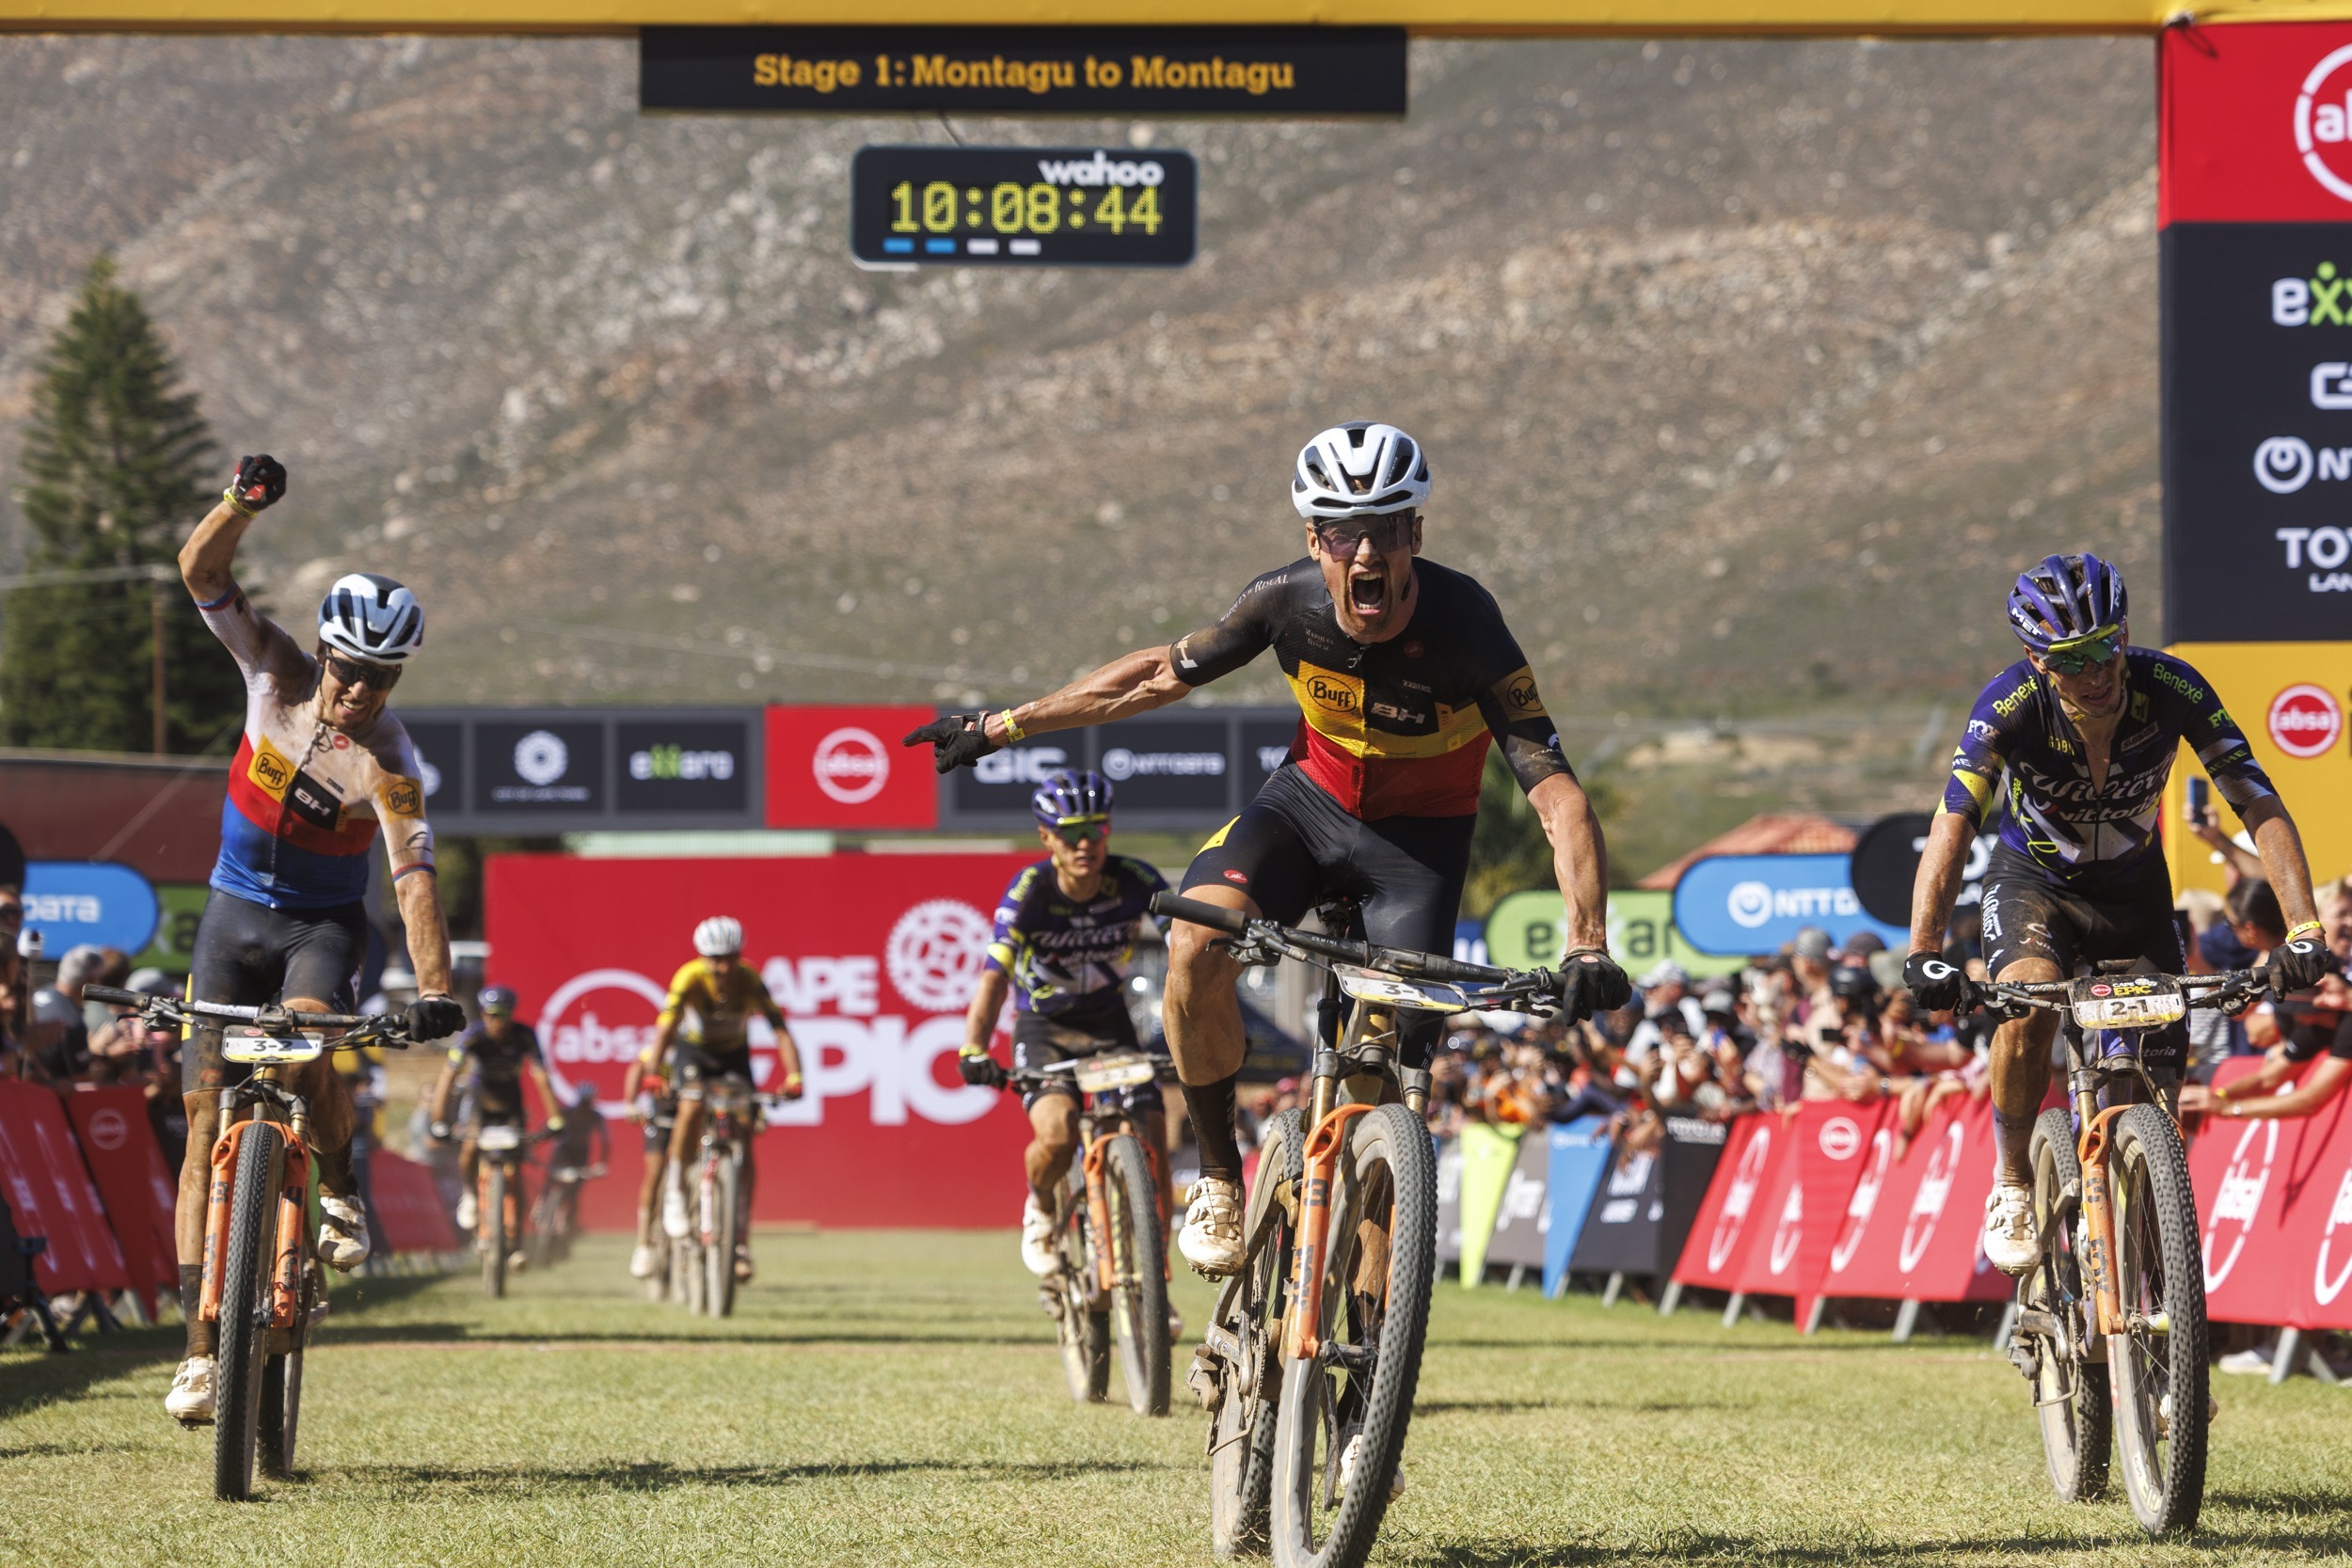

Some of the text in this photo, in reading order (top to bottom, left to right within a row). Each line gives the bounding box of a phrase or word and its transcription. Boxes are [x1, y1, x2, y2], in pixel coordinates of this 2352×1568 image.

[754, 54, 1295, 95] Stage 1: Montagu to Montagu
[1039, 150, 1164, 185] wahoo
[891, 181, 1163, 235] 10:08:44
[2011, 607, 2042, 636] MET
[1371, 702, 1425, 724] BH
[294, 786, 331, 816] BH
[1311, 935, 1338, 945] GEMINI
[762, 955, 880, 1015] APE
[2113, 985, 2153, 996] EPIC
[2110, 999, 2149, 1016] 2-1
[253, 1039, 293, 1053] 3-2
